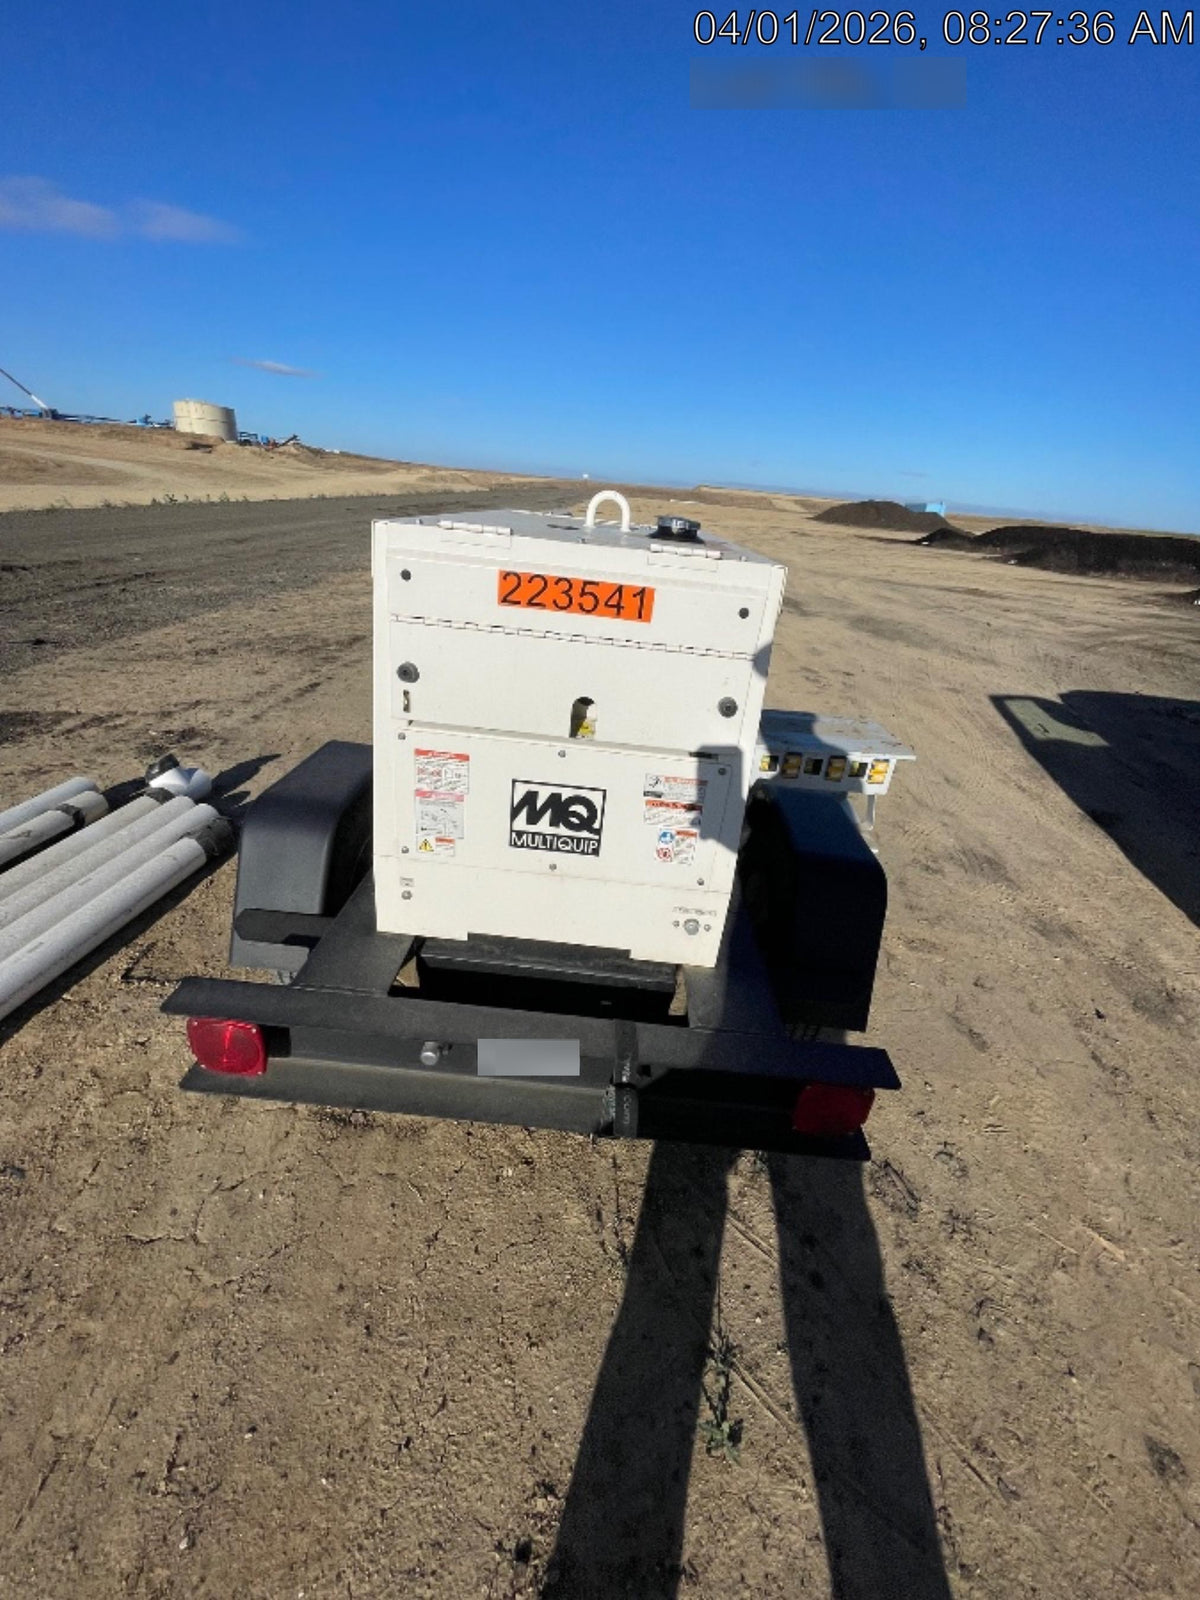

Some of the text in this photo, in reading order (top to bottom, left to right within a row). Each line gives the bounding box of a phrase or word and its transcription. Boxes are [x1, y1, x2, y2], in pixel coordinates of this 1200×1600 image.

[500, 571, 648, 620] 223541
[511, 790, 601, 836] MQ
[511, 831, 598, 854] MULTIQUIP
